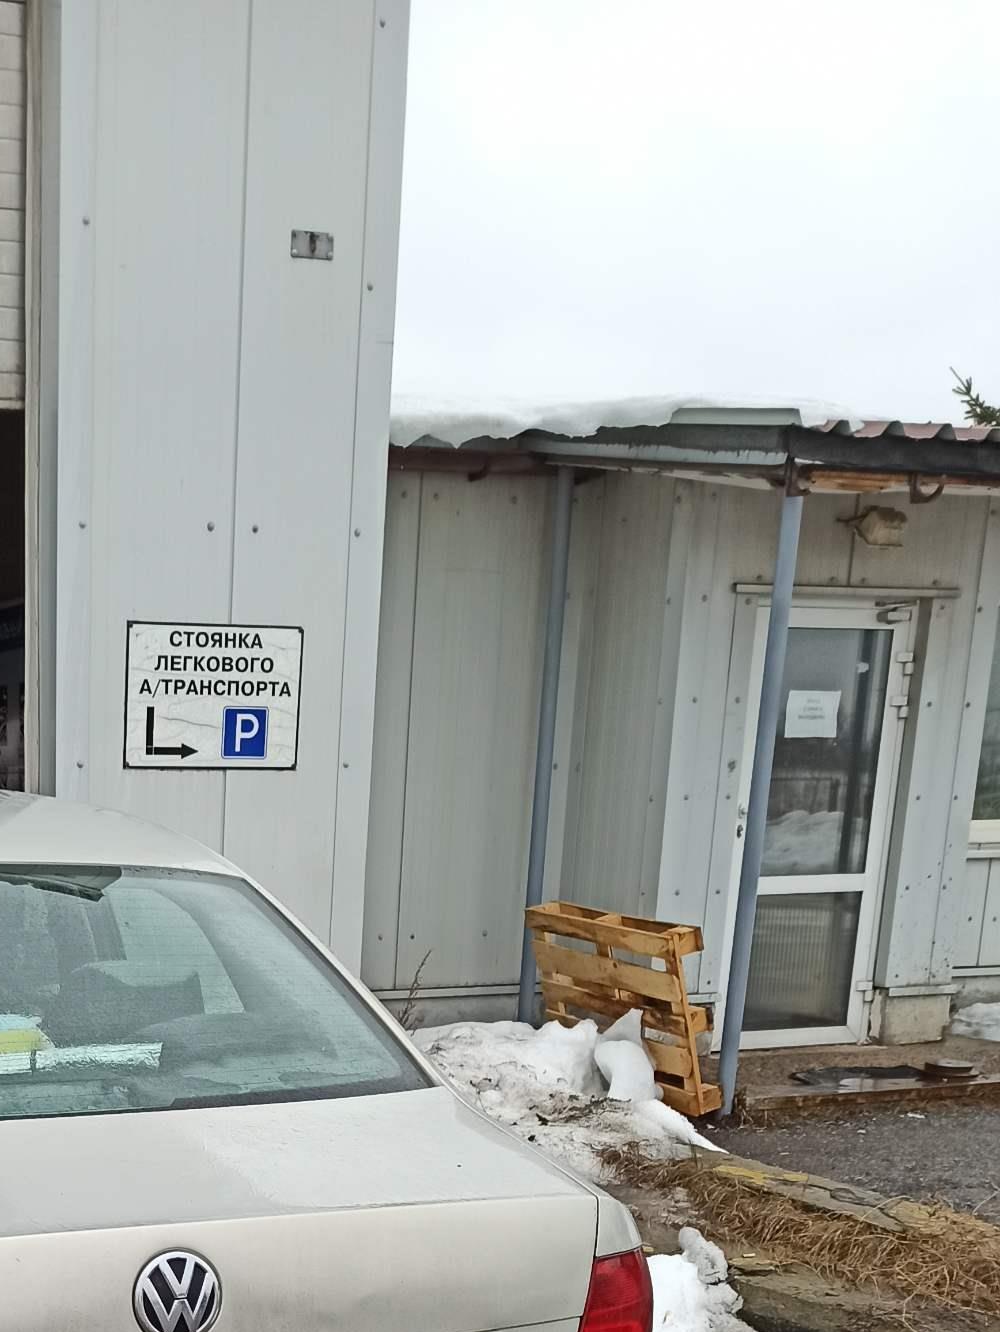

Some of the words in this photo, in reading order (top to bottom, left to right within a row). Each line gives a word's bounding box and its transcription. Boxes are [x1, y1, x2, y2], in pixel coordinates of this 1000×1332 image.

[168, 630, 264, 650] СТОЯНКА
[154, 655, 275, 674] ЛЕГКОВОГО
[138, 678, 292, 698] А/ТРАНСПОРТА
[234, 712, 260, 753] P
